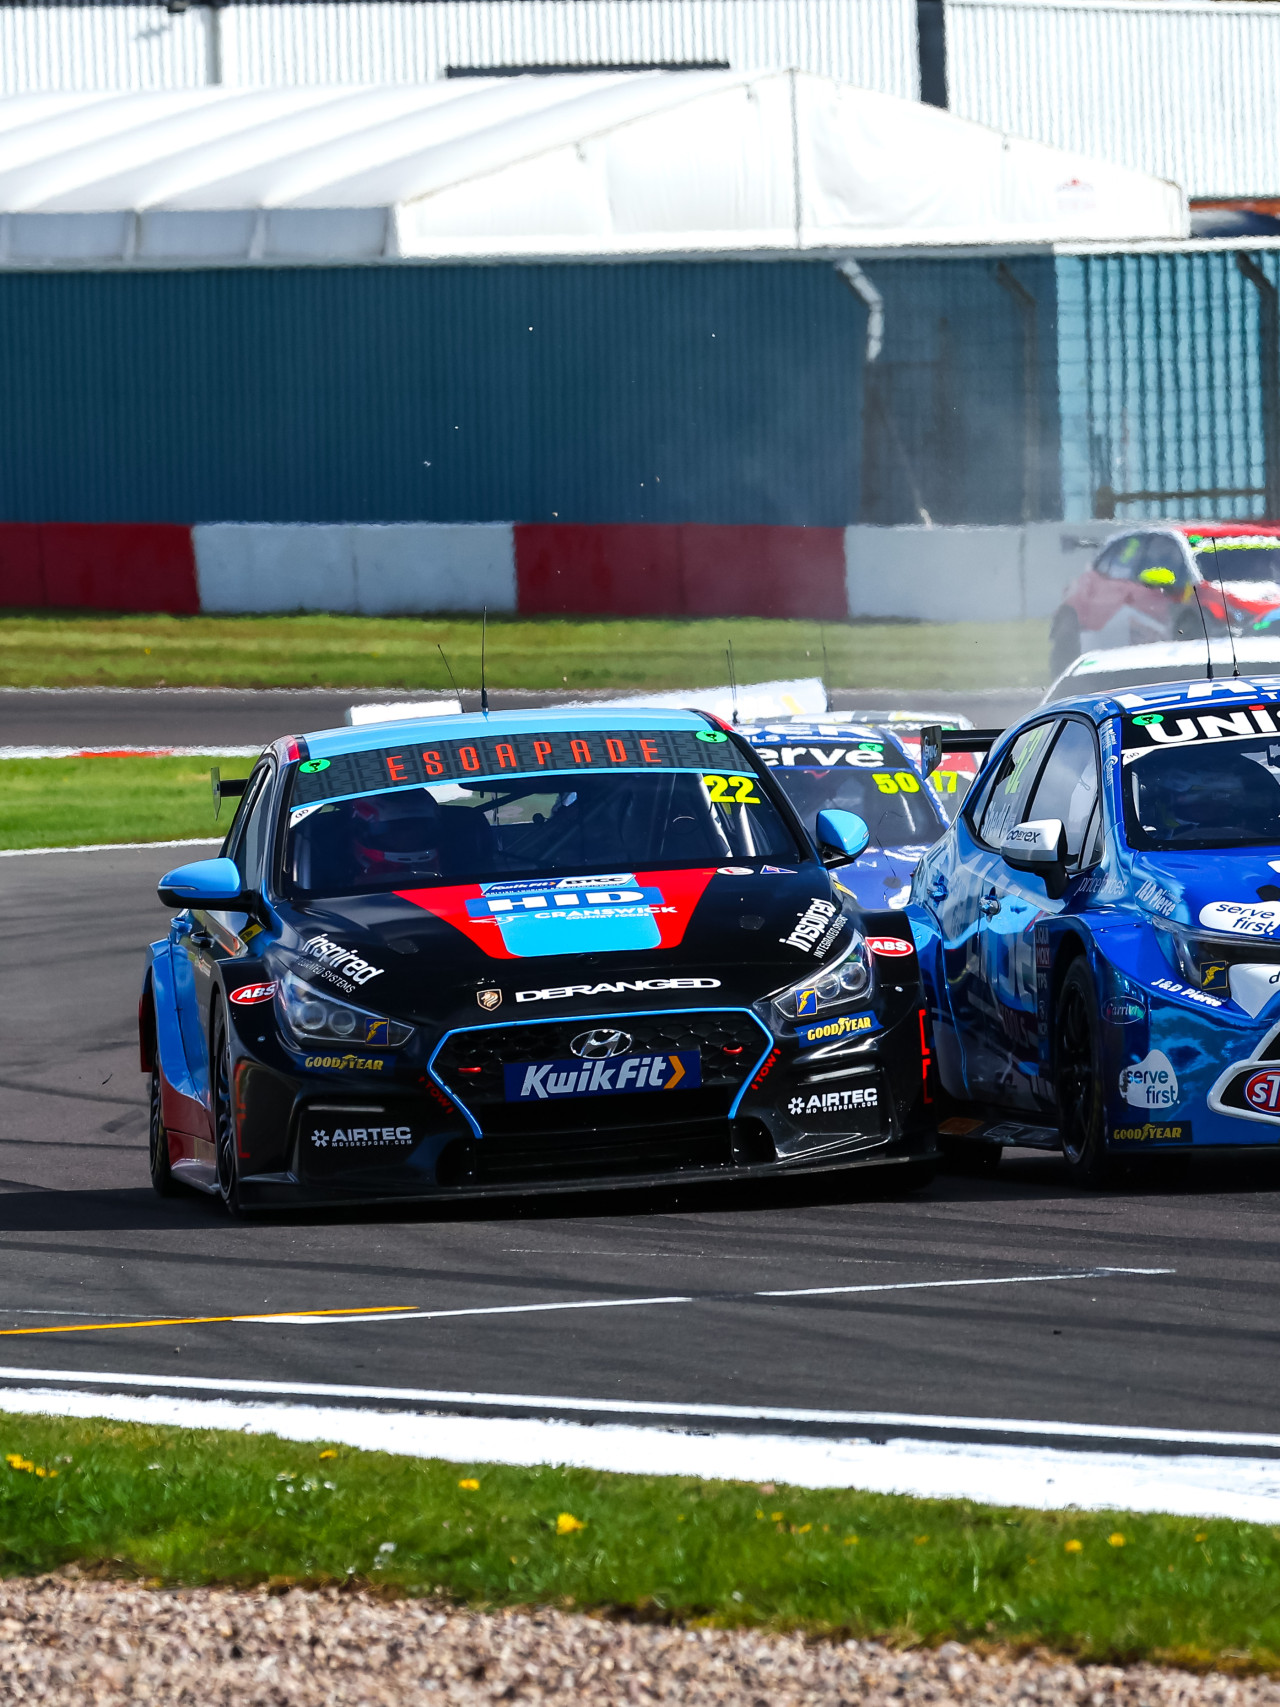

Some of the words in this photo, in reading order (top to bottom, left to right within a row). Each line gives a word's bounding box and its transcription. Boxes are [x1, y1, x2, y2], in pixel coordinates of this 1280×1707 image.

[702, 774, 761, 804] 22
[871, 772, 920, 794] 50
[930, 770, 958, 793] 17
[487, 891, 644, 912] HID
[1215, 902, 1276, 920] serve
[534, 906, 678, 919] CRANSWICK
[778, 897, 837, 953] inspired
[871, 940, 908, 951] ABS
[301, 933, 386, 985] inspired
[236, 983, 276, 1001] ABS
[320, 969, 356, 994] SYSTEMS
[515, 978, 721, 1003] DERANGED
[1151, 978, 1183, 992] J&D
[1180, 987, 1222, 1007] Pierce
[807, 1016, 872, 1041] GOODYEAR
[304, 1055, 383, 1071] GOODYEAR
[755, 1055, 777, 1083] TOW
[520, 1056, 667, 1099] KwikFit
[1127, 1069, 1169, 1085] serve
[806, 1088, 878, 1107] AIRTEC
[806, 1101, 878, 1113] MOORSPORT.COM
[332, 1126, 412, 1142] AIRTEC
[1113, 1124, 1182, 1141] GOODYEAR
[332, 1140, 412, 1148] MOTORSPORT.COM
